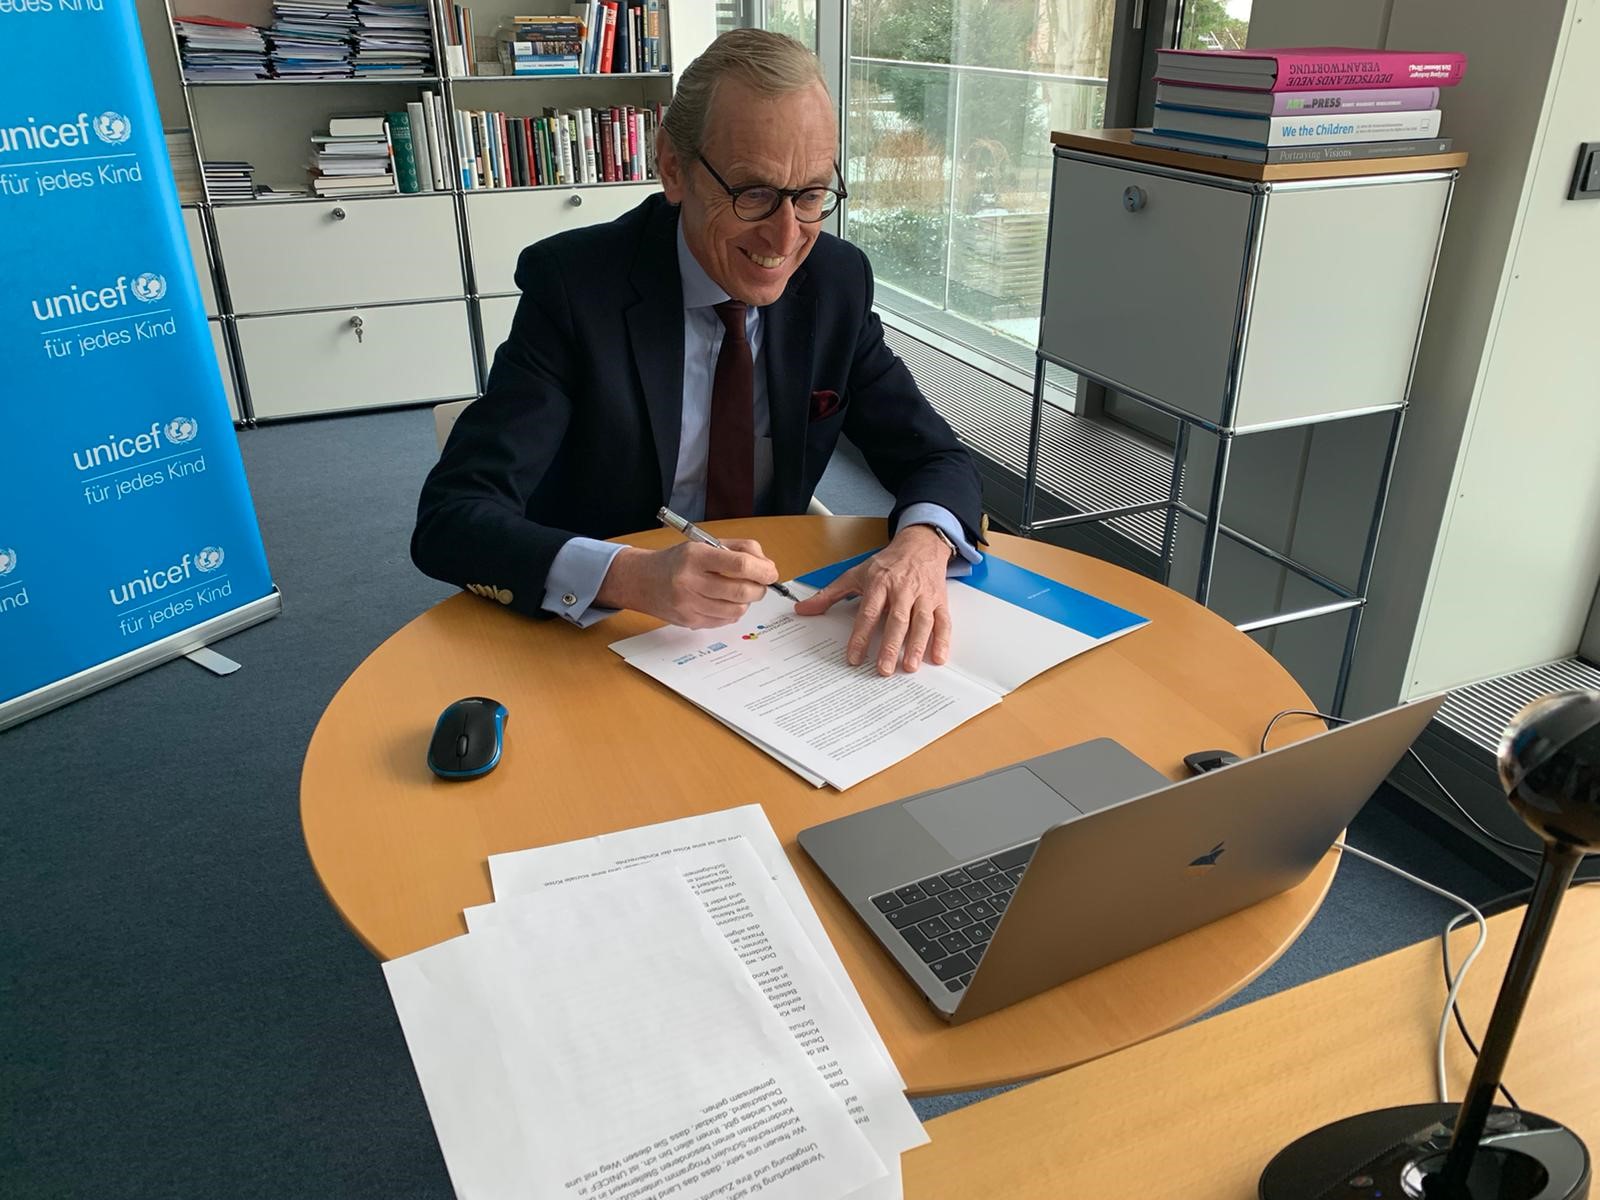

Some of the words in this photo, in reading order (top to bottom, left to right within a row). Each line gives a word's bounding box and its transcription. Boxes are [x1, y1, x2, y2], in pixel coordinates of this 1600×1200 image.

[1286, 77, 1317, 87] NEUE
[1289, 61, 1380, 73] VERANTWORTUNG
[1323, 73, 1393, 86] DEUTSCHLANDS
[1311, 97, 1342, 109] PRESS
[0, 113, 89, 151] unicef
[1282, 126, 1297, 137] We
[1299, 125, 1313, 135] the
[1316, 122, 1354, 135] Children
[0, 173, 30, 195] für
[36, 169, 95, 196] jedes
[98, 162, 142, 185] Kind
[32, 276, 128, 320] unicef
[43, 336, 72, 359] für
[77, 327, 132, 357] jedes
[135, 317, 176, 339] Kind
[72, 423, 162, 471] unicef
[84, 485, 111, 504] für
[114, 471, 164, 500] jedes
[168, 455, 206, 481] Kind
[110, 554, 191, 606] unicef
[0, 588, 29, 612] ind
[120, 617, 144, 636] für
[149, 601, 194, 628] jedes
[196, 581, 232, 606] Kind
[591, 1170, 628, 1193] UNICEF
